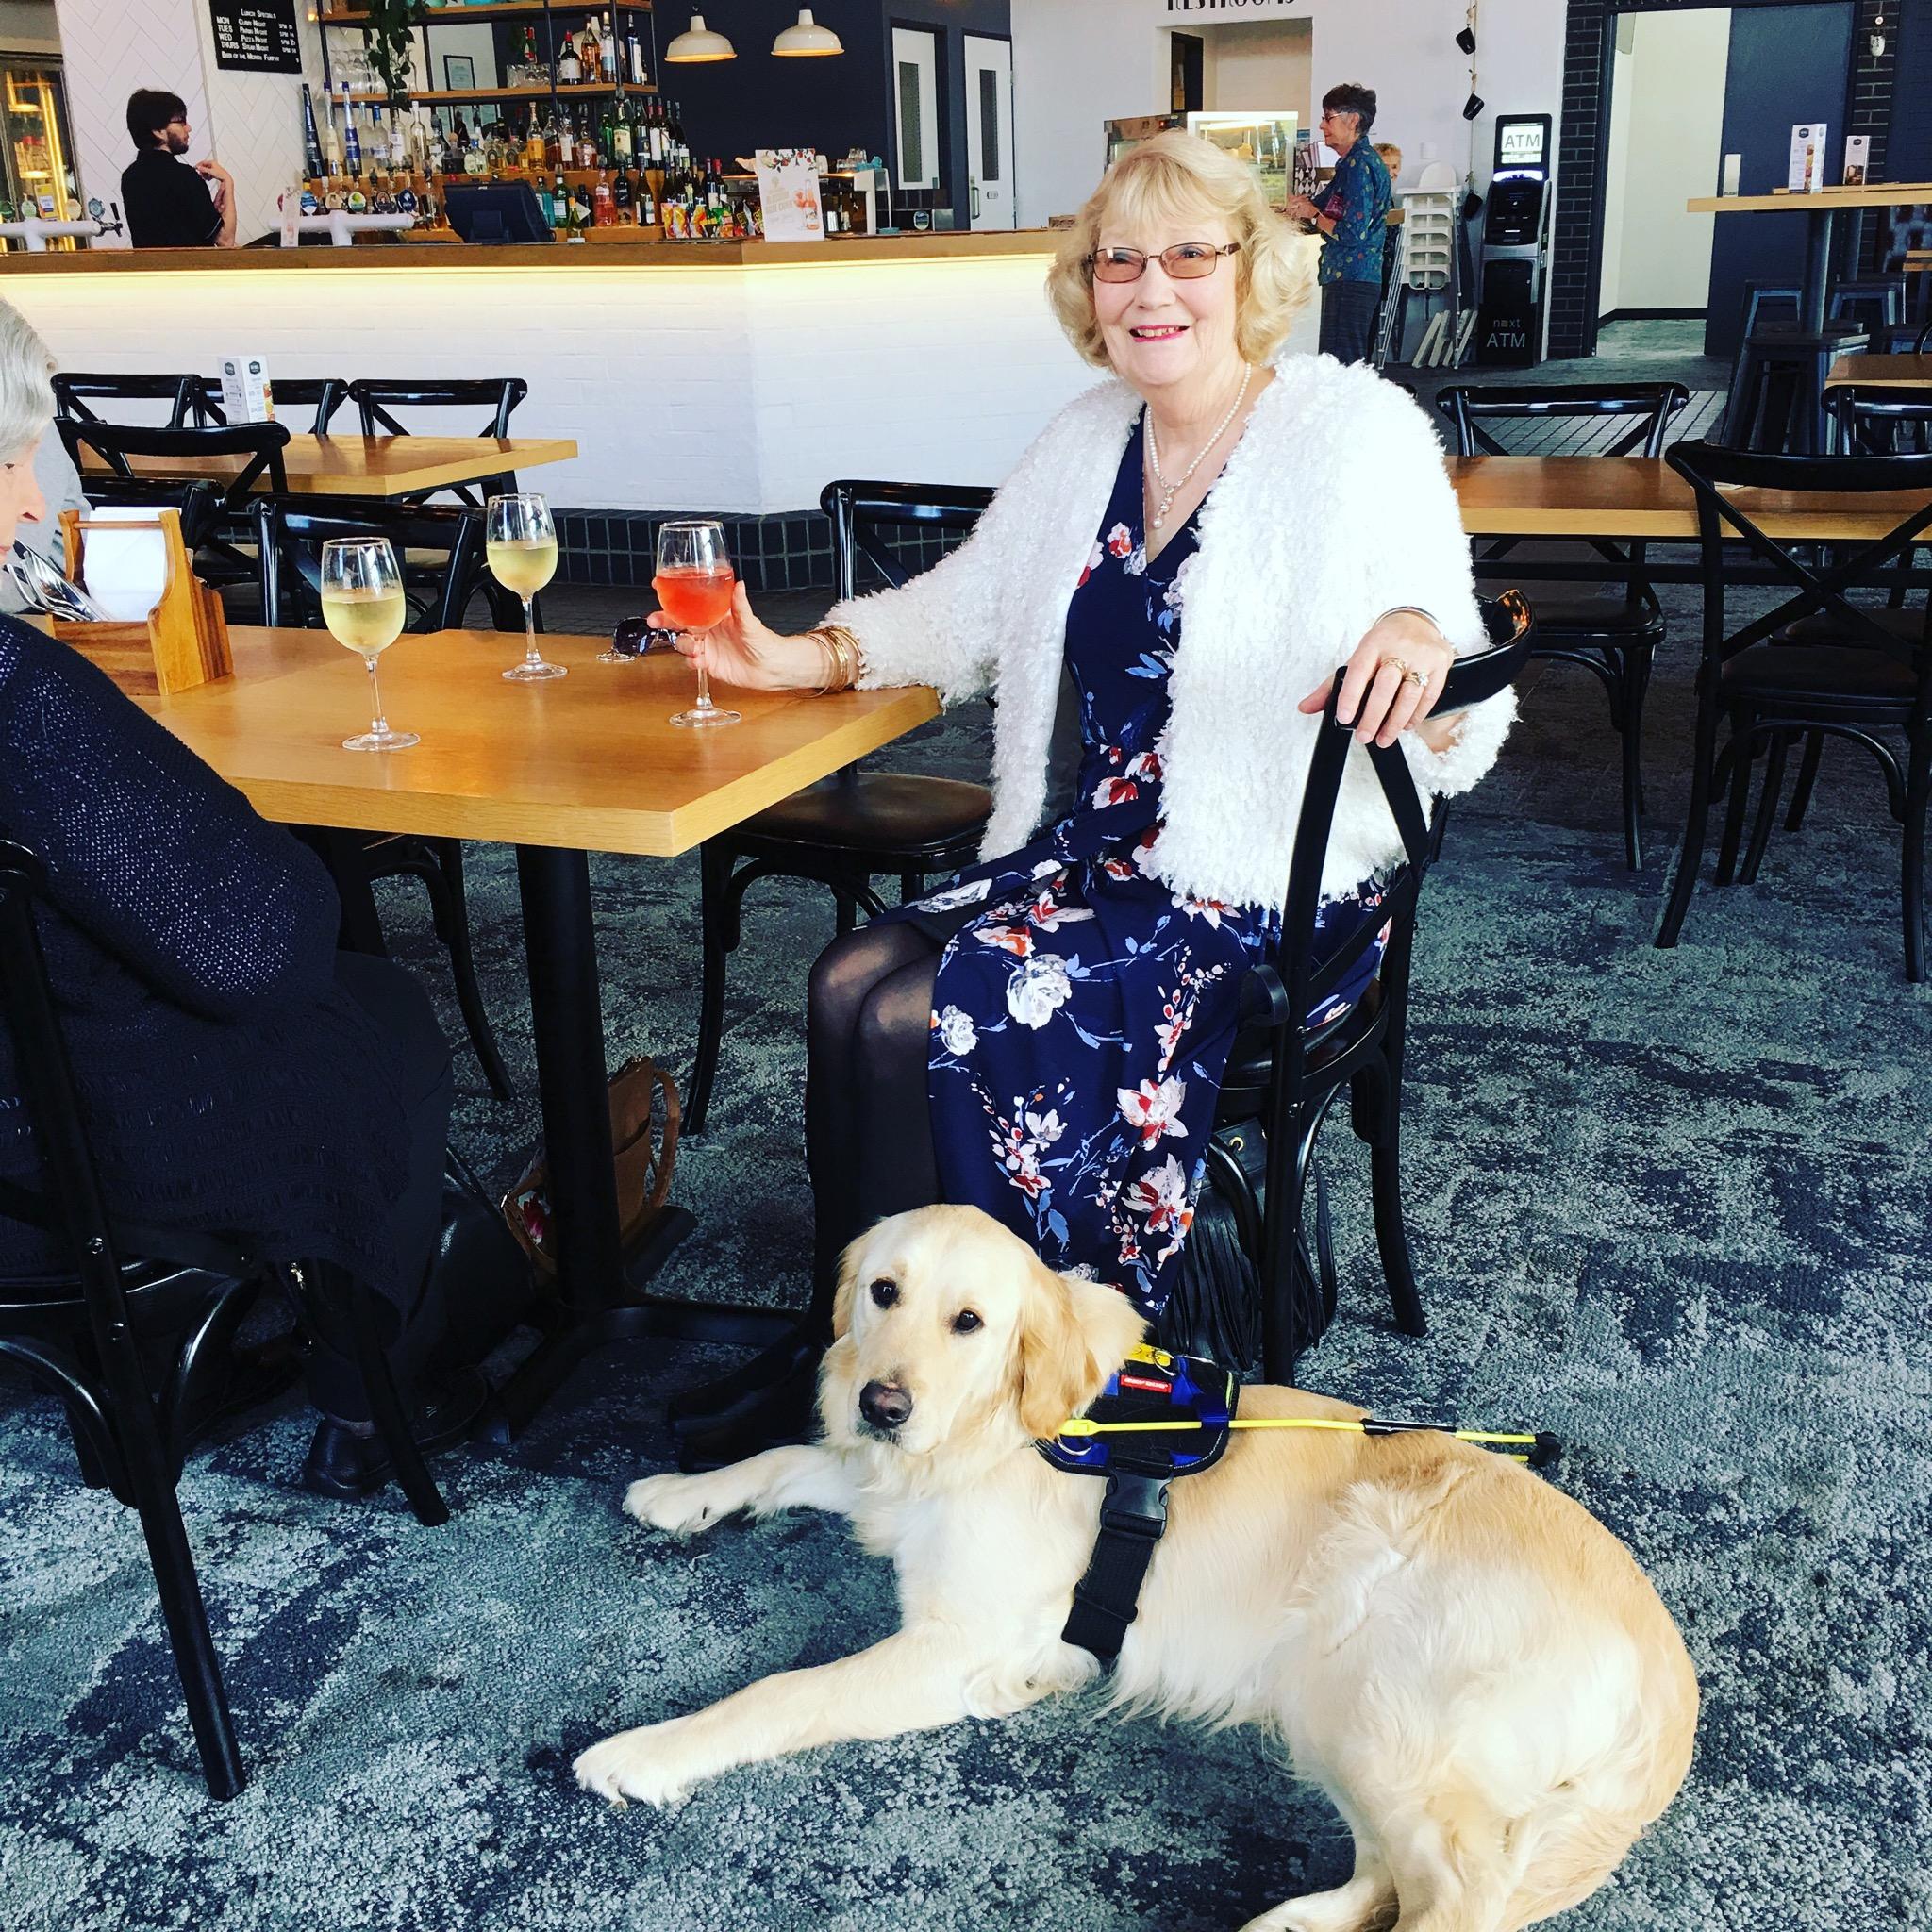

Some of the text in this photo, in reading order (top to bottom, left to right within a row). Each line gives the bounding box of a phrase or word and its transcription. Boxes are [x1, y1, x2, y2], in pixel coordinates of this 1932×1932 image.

[216, 16, 230, 25] MON
[217, 25, 233, 33] TUES
[218, 33, 232, 42] WED
[220, 41, 240, 50] THURS
[1504, 134, 1541, 148] ATM
[1493, 318, 1521, 328] next
[1486, 332, 1526, 348] ATM
